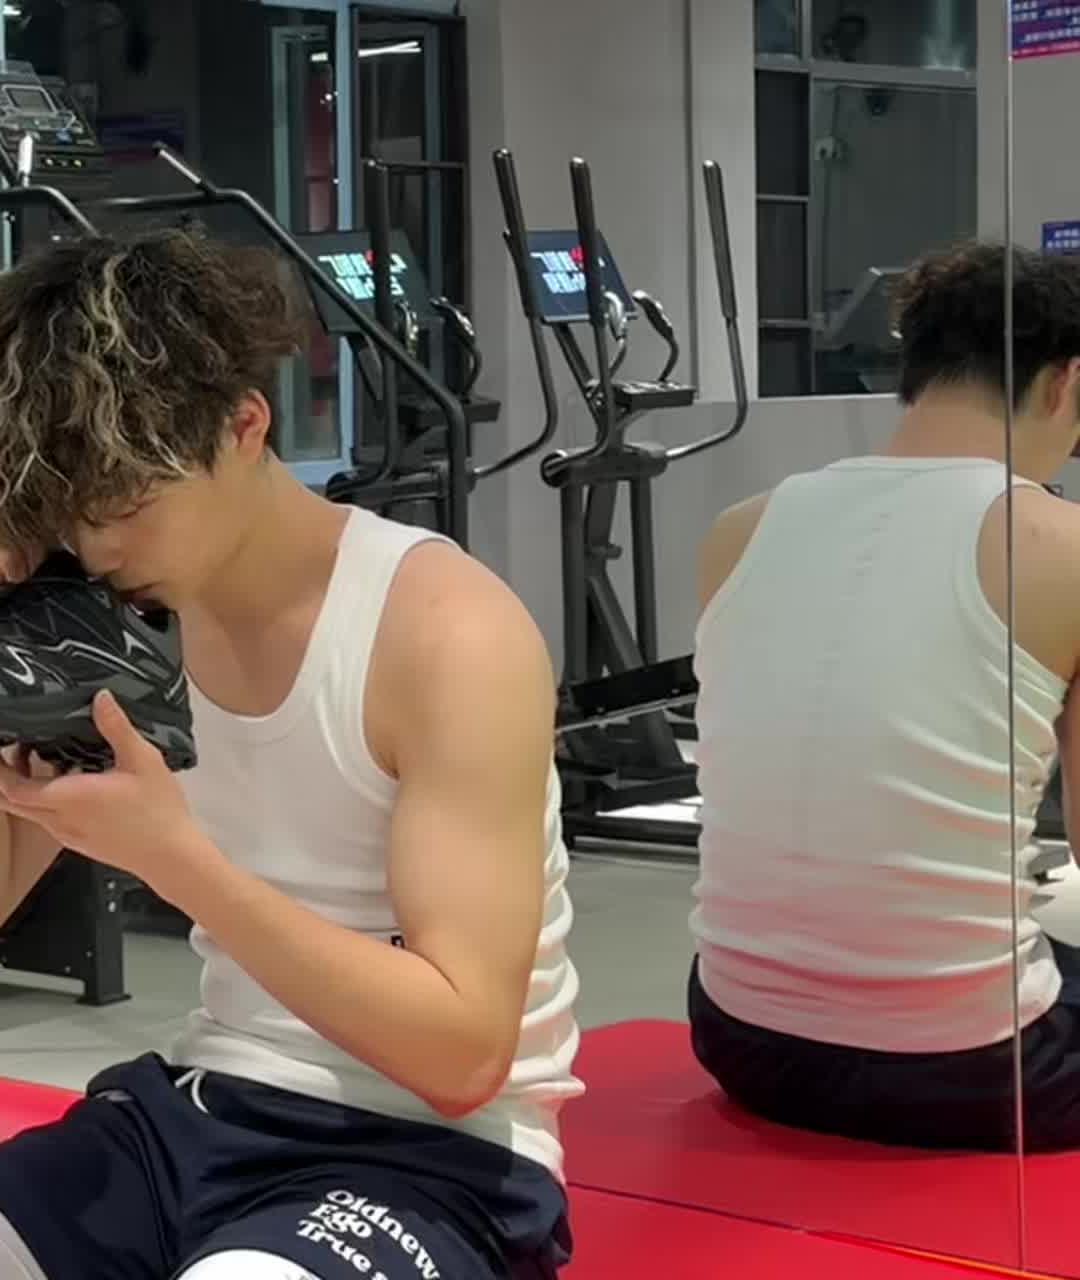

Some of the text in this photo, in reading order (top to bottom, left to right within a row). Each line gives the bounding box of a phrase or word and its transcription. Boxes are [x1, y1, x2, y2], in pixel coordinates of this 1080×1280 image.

[296, 1219, 371, 1272] True
[309, 1203, 372, 1238] Ego
[326, 1189, 440, 1280] Oldnew
